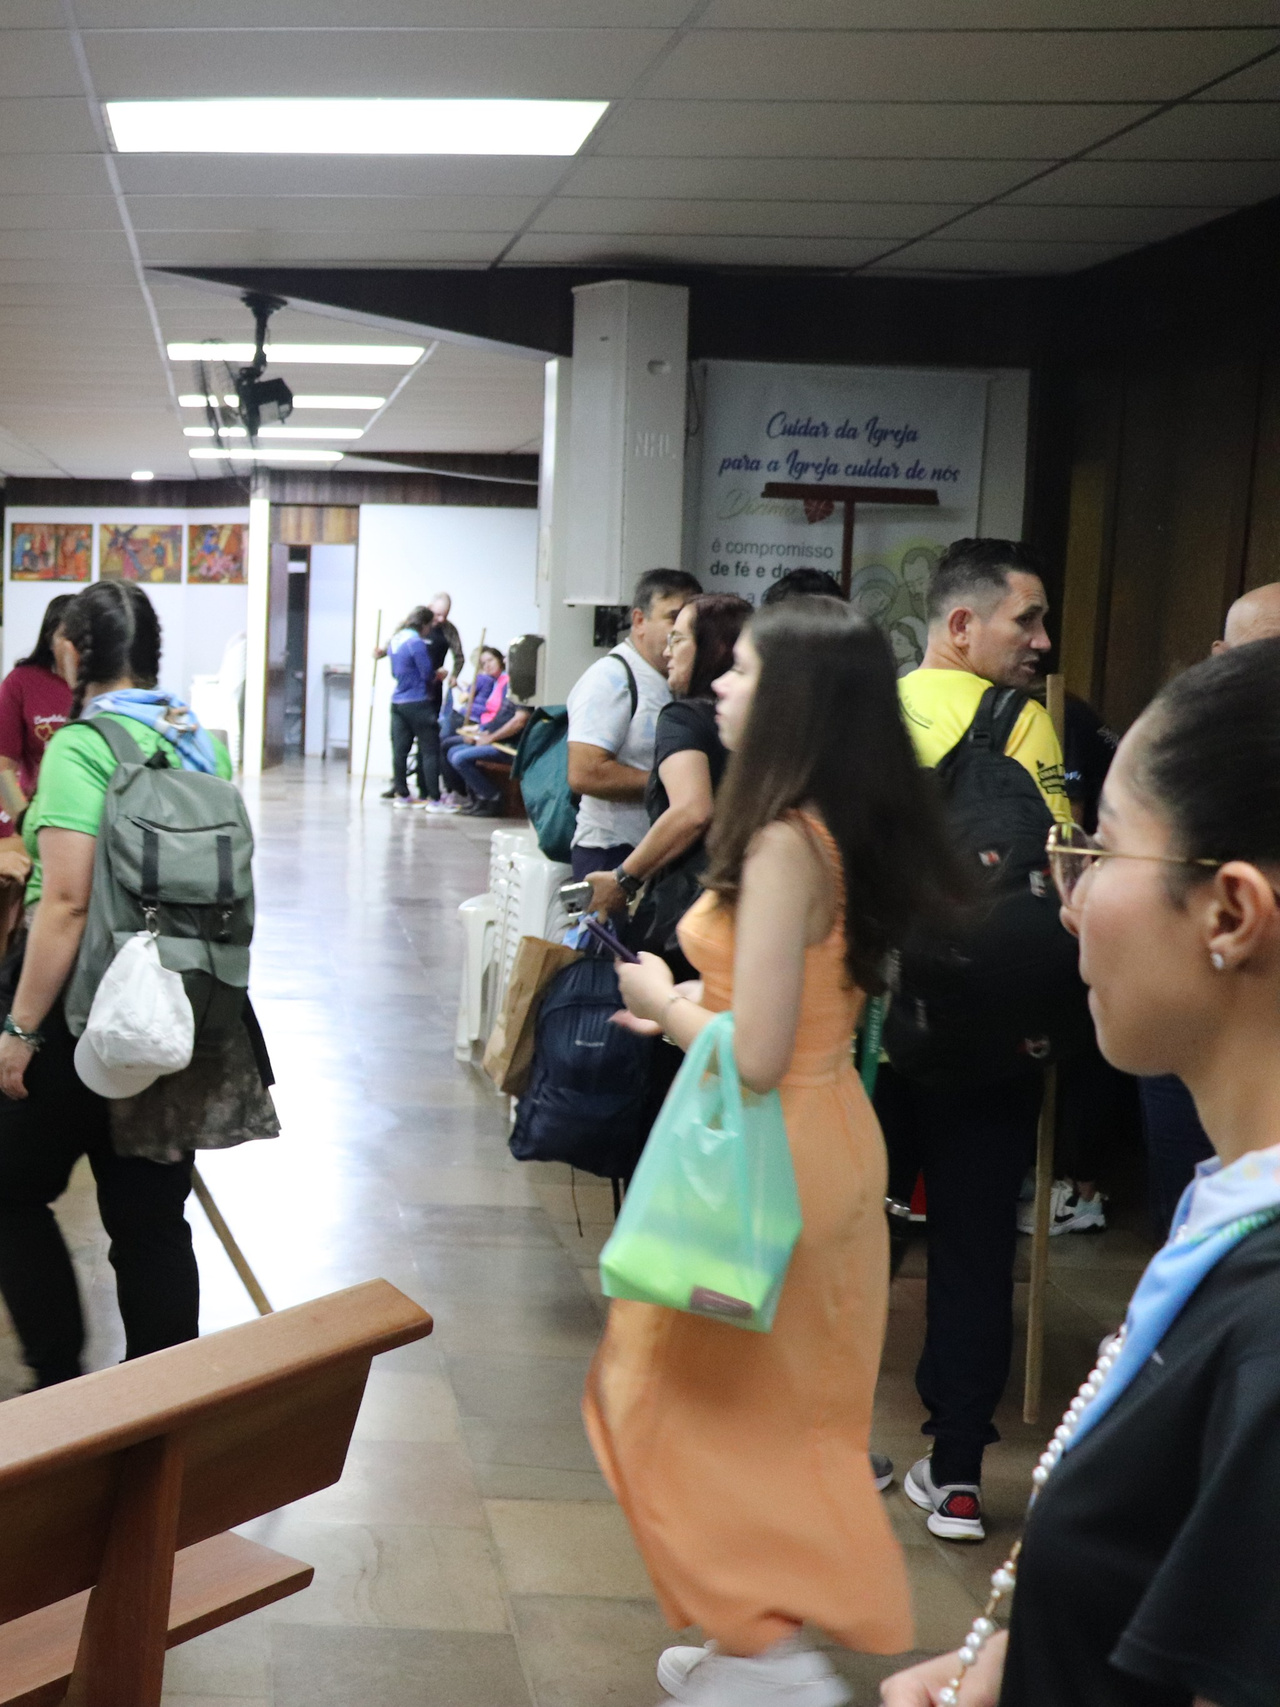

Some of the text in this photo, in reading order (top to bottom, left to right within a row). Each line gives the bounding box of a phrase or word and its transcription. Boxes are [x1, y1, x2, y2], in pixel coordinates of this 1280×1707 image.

[766, 411, 919, 449] Cuidar da Igreja
[718, 453, 761, 477] para
[766, 458, 781, 473] a
[786, 449, 839, 482] Igreja
[844, 455, 901, 480] cuidar
[905, 459, 926, 481] de
[725, 540, 834, 560] compromisso
[710, 561, 729, 577] de
[734, 561, 750, 578] fé
[755, 567, 766, 579] e
